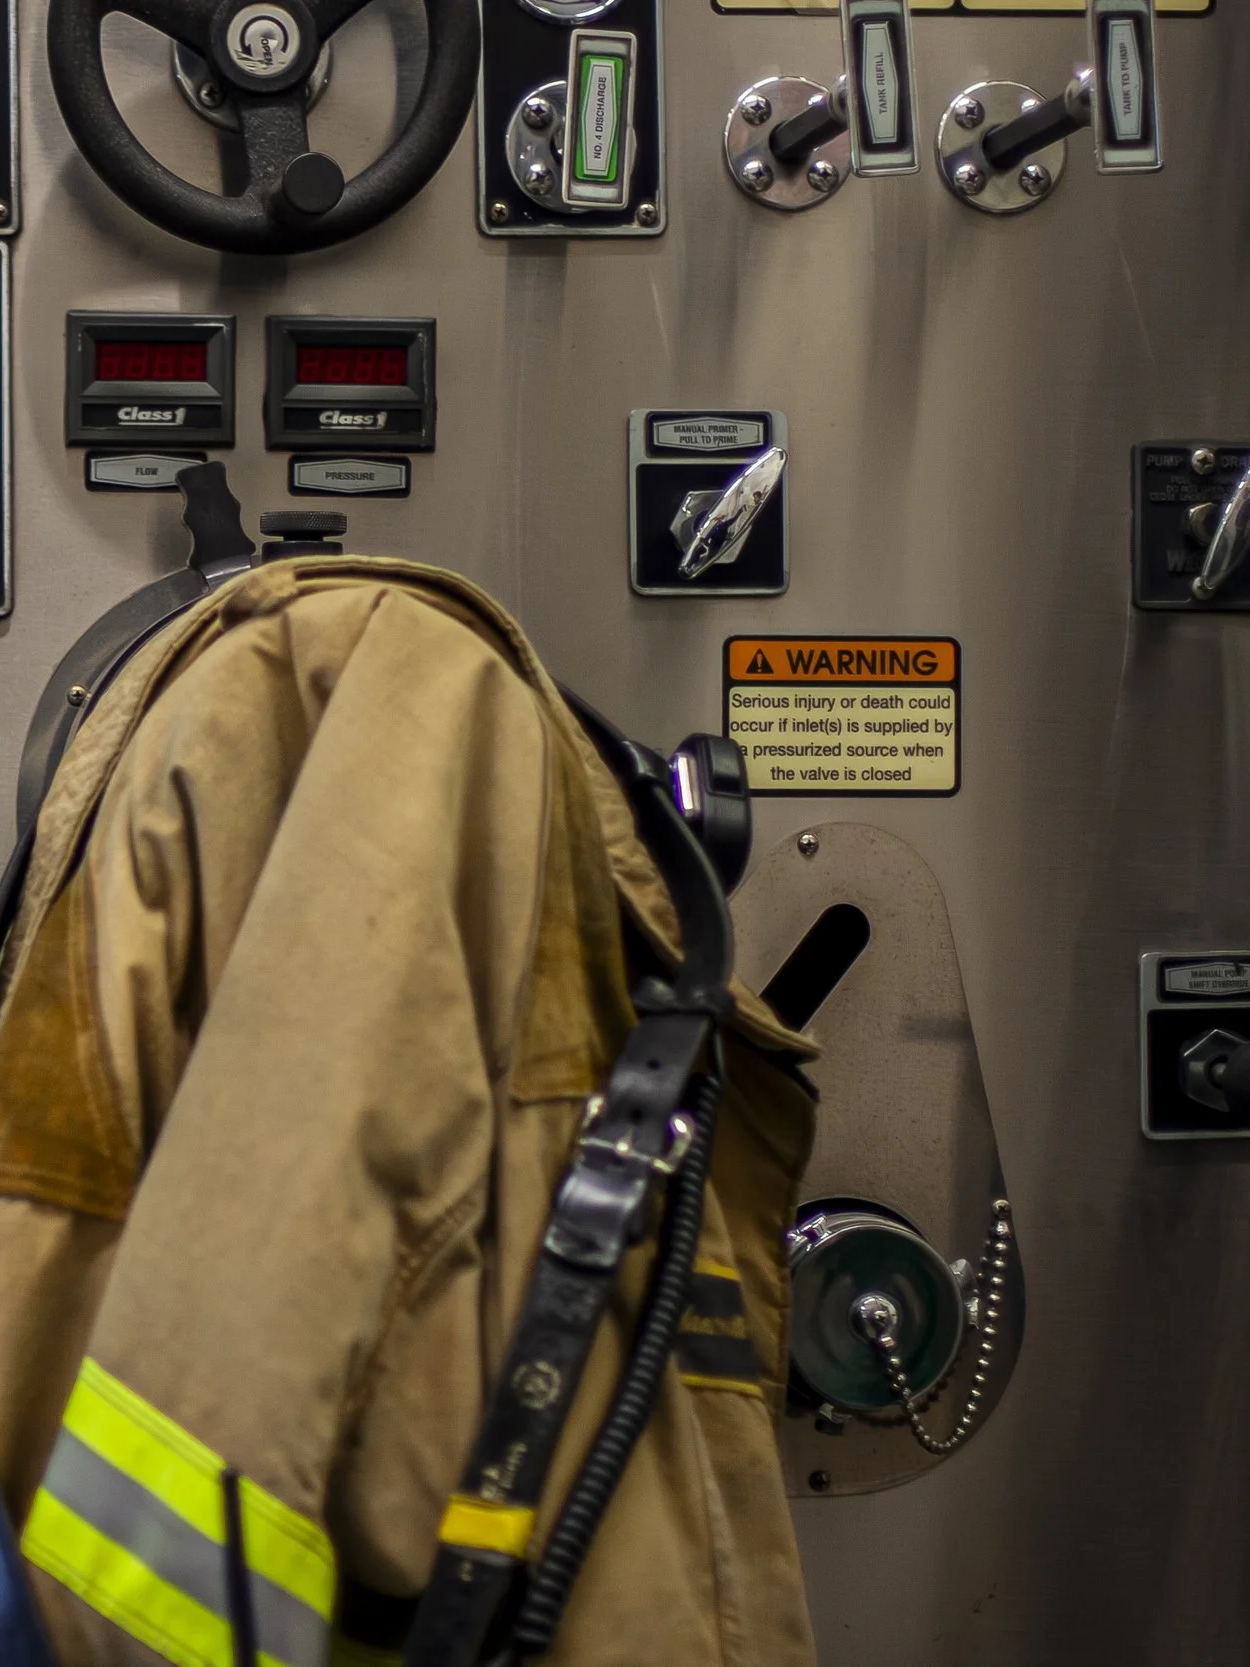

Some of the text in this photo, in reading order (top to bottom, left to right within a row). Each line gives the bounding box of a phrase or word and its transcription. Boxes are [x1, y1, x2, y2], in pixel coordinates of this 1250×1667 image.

[874, 52, 888, 114] TANK REFILL
[1119, 42, 1133, 116] TANK TO PUMP
[595, 76, 607, 132] DISCHARGE
[674, 425, 738, 433] MANUAL PRIMER
[679, 436, 738, 444] PULL TO PRIME
[1146, 455, 1182, 467] PUMP
[135, 467, 159, 476] FLOW
[325, 471, 375, 481] PRESSURE
[786, 649, 939, 676] WARNING
[731, 693, 951, 712] Serious injury or death could
[730, 718, 954, 737] occur if inlet(s) is supplied by
[752, 742, 842, 760] pressurized
[846, 745, 898, 757] source
[903, 743, 944, 757] when
[770, 766, 912, 781] the valve is closed
